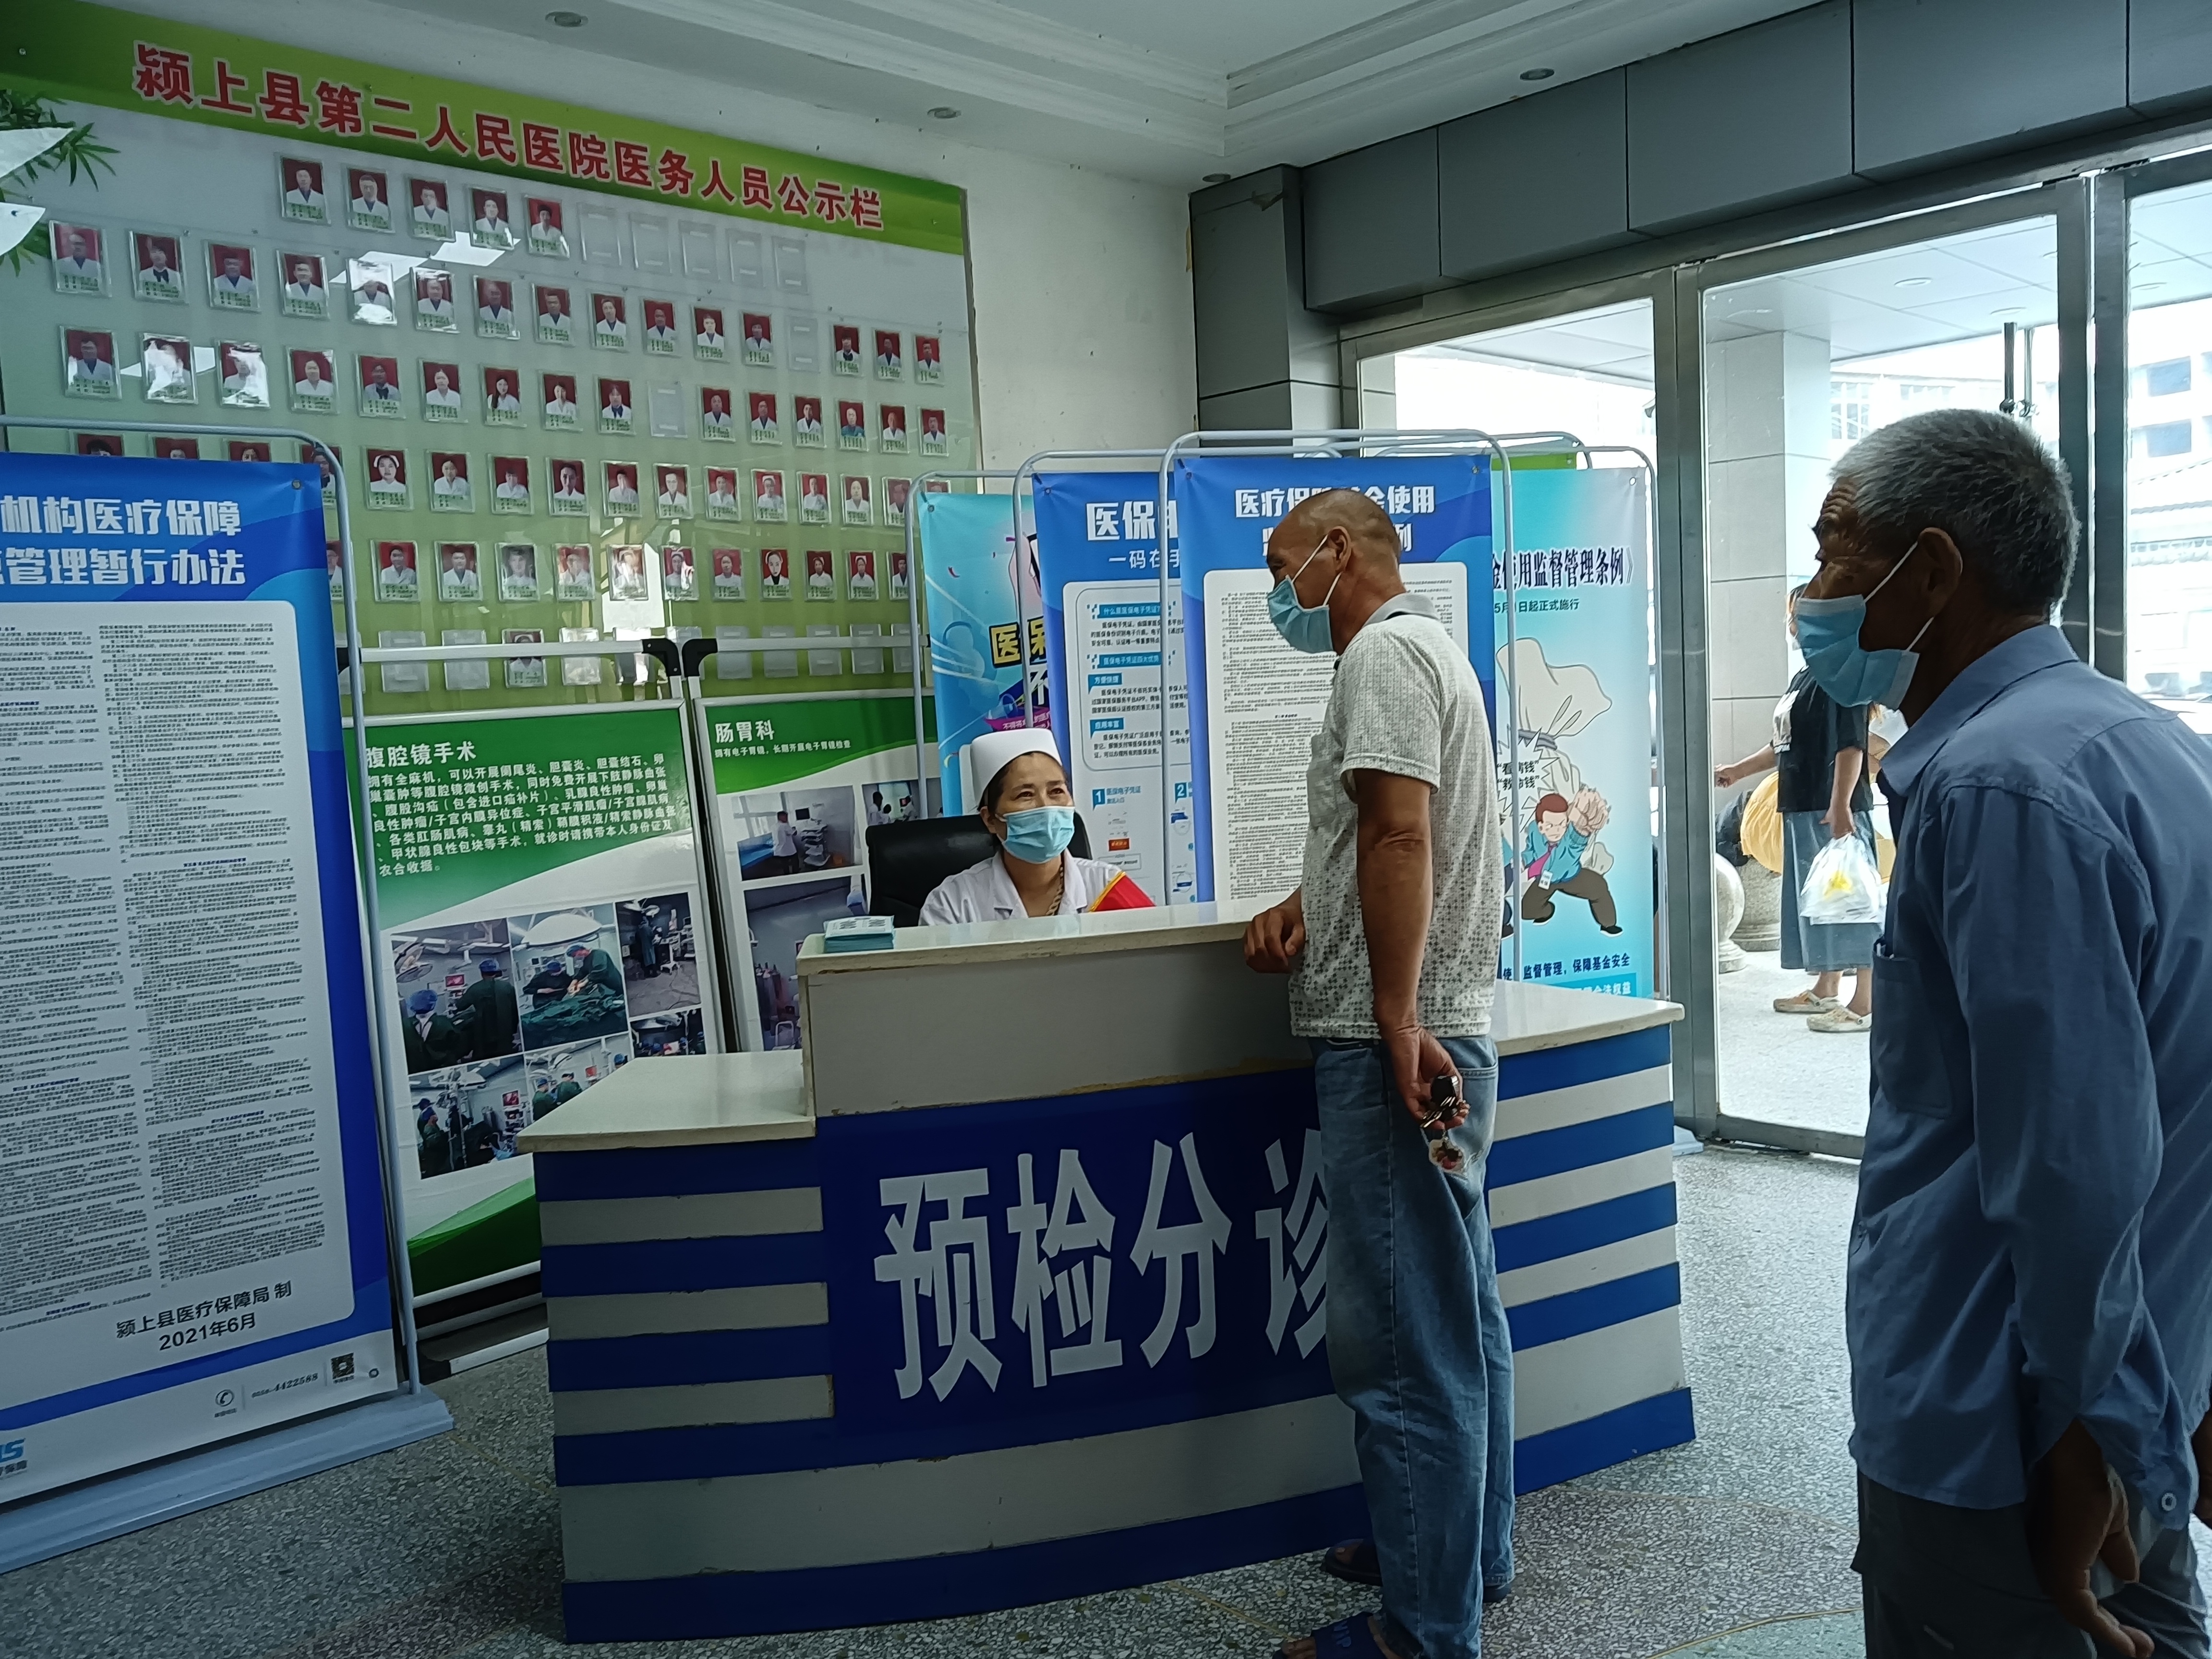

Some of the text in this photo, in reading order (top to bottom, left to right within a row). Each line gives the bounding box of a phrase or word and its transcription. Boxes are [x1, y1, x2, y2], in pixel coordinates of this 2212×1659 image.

[135, 43, 882, 229] 颍上县第二人民医院医务人员公示栏
[0, 495, 241, 536] 机构医疗保障
[0, 547, 246, 586] 管理暂行办法
[715, 720, 775, 744] 肠胃科
[365, 741, 477, 769] 腹腔镜手术
[1095, 790, 1102, 803] 1
[1177, 784, 1185, 797] 2
[874, 1129, 1329, 1401] 预检分诊
[116, 1280, 292, 1338] 颍上县医疗保障局 制
[158, 1312, 256, 1351] 2021年6月
